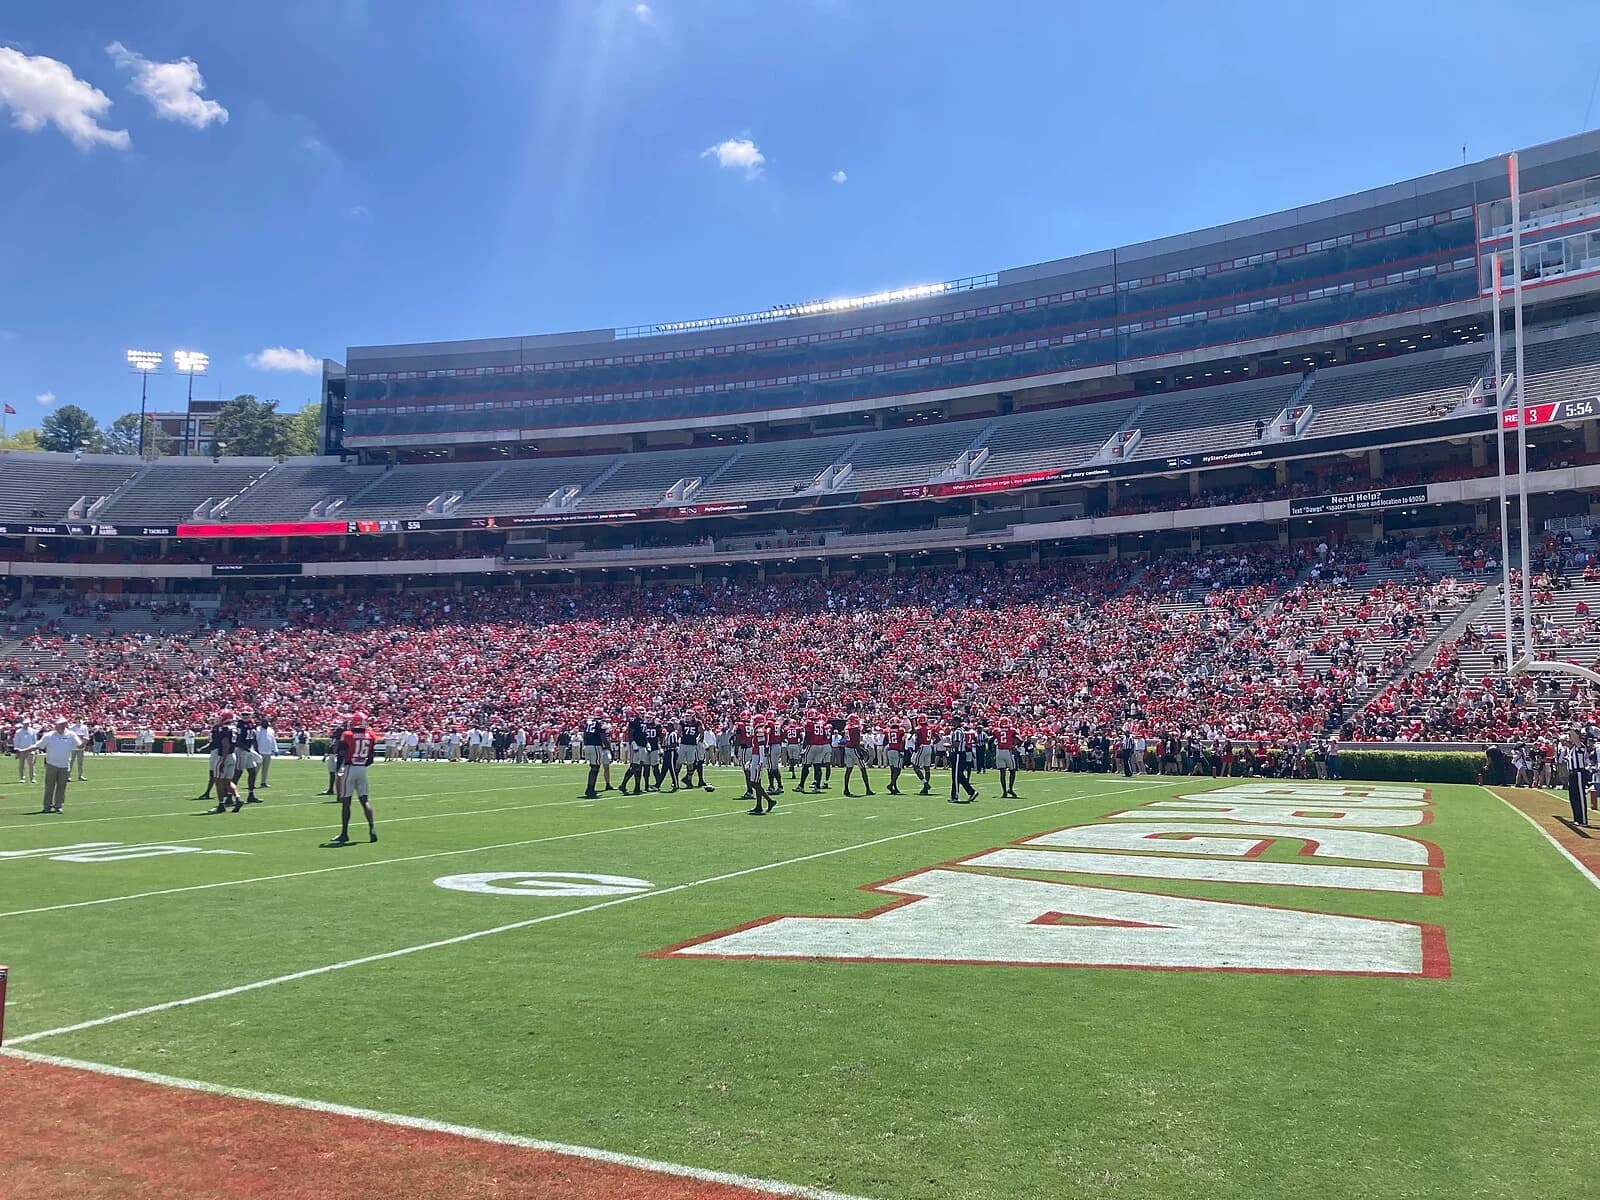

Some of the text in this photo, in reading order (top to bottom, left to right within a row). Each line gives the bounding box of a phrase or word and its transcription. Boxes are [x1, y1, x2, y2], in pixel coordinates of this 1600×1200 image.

[1565, 401, 1593, 417] 5:54
[1504, 409, 1538, 423] RE 3
[1202, 450, 1263, 462] MyStoryContinues.com
[1331, 492, 1382, 504] Need Help?
[1292, 507, 1303, 515] Text
[1370, 499, 1380, 507] and
[1380, 498, 1402, 506] location
[90, 525, 97, 536] 7
[684, 726, 696, 736] 75
[1000, 731, 1008, 743] 2
[888, 731, 898, 744] 12
[352, 738, 370, 758] 16
